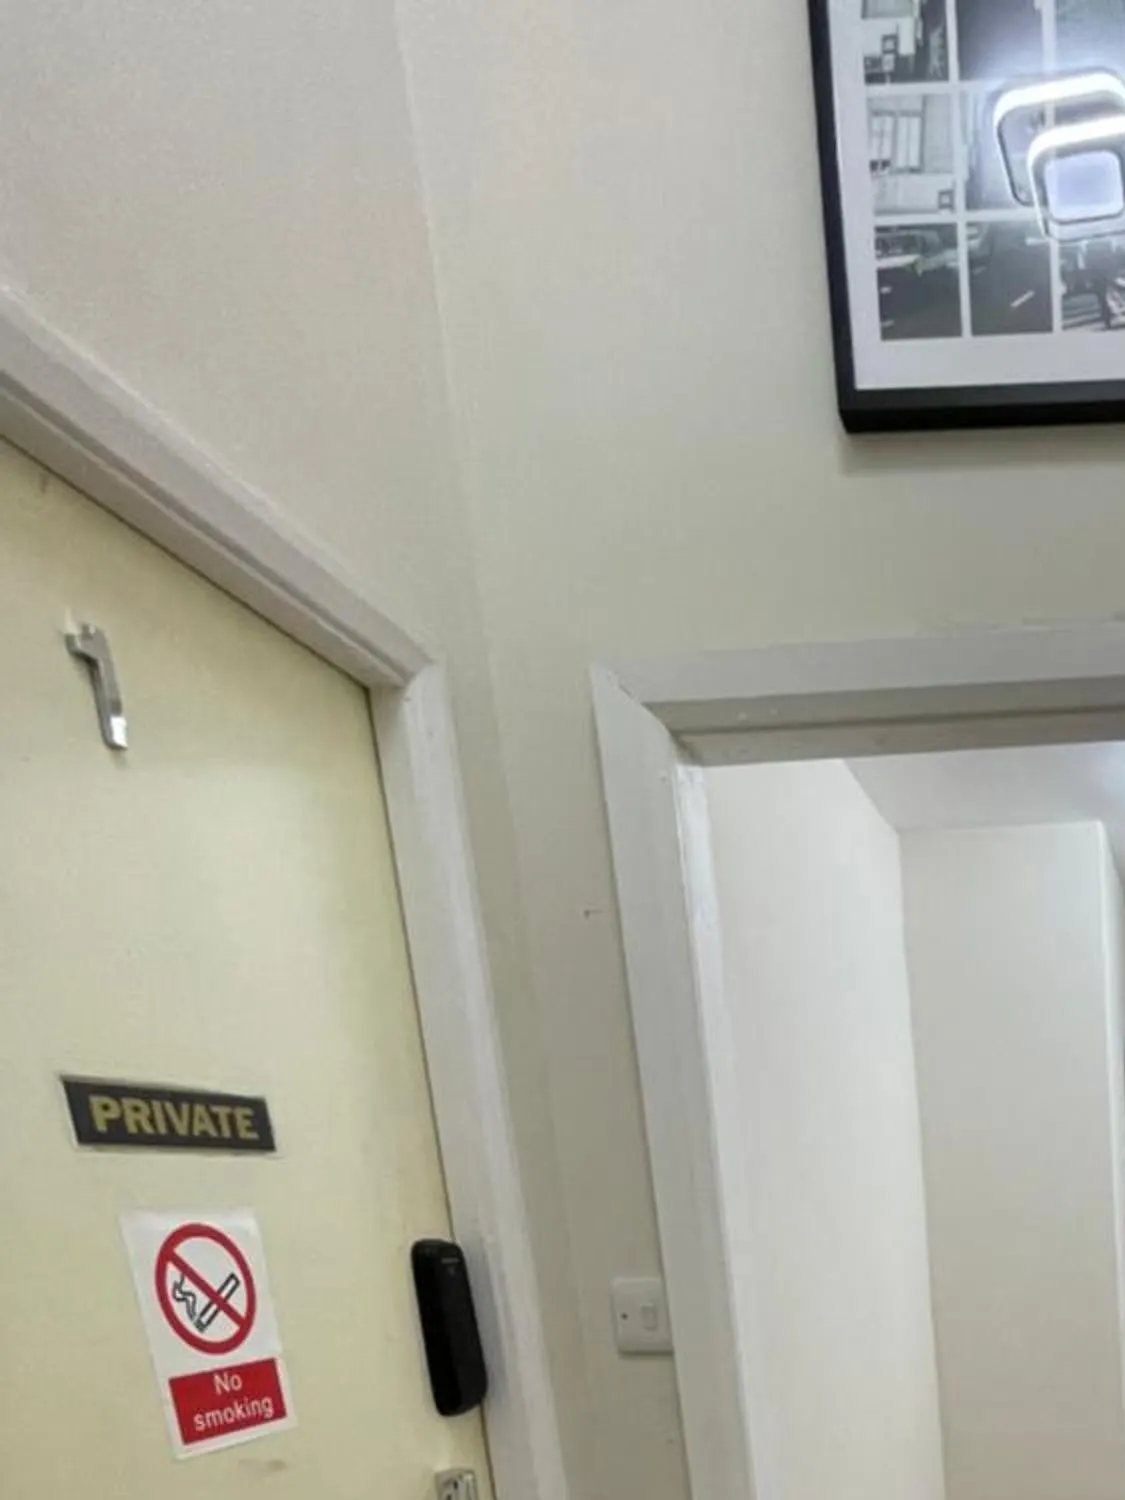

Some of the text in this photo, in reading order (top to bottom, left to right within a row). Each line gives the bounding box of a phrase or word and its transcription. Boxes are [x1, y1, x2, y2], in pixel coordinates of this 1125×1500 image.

[64, 622, 128, 750] 1
[90, 1095, 259, 1138] PRIVATE
[213, 1373, 243, 1394] No
[193, 1396, 274, 1431] smoking
